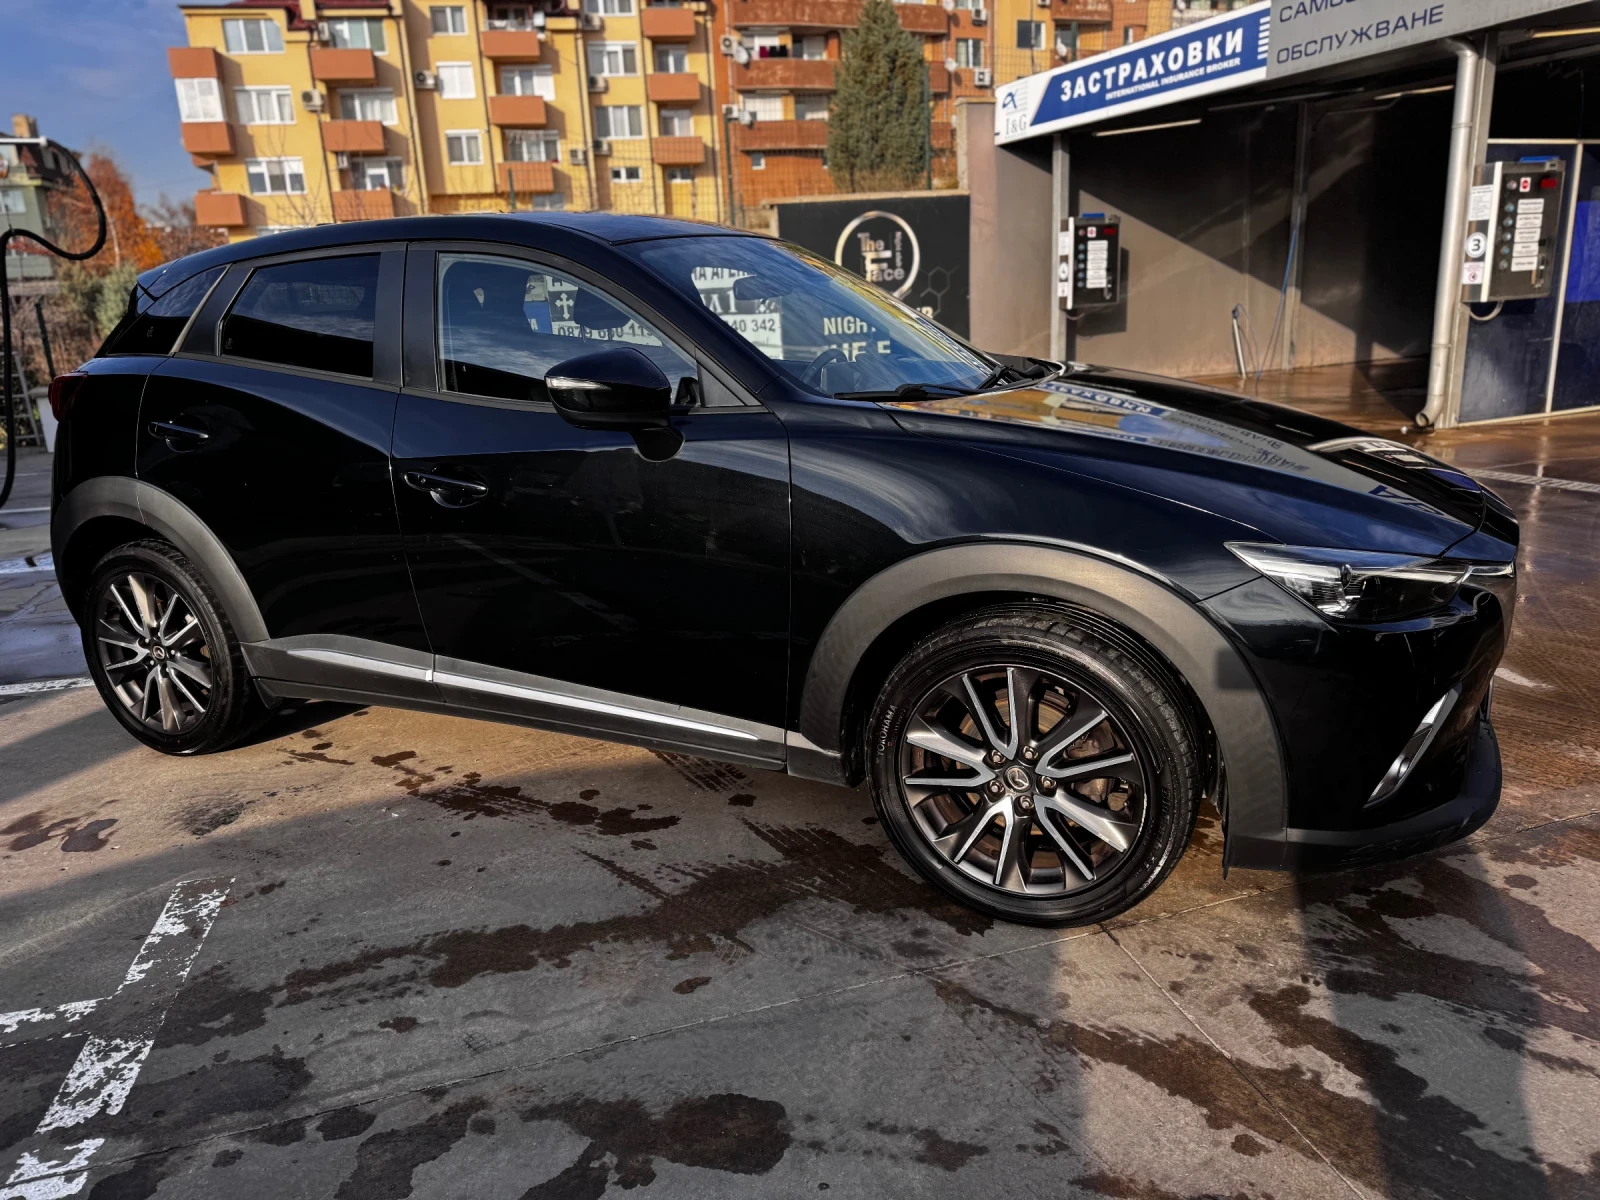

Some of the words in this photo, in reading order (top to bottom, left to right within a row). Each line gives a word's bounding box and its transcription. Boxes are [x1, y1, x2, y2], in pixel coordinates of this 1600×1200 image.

[1276, 4, 1445, 64] ОБСЛУЖВАНЕ
[1060, 27, 1244, 102] ЗАСТРАХОВКИ
[1105, 79, 1160, 100] INTERNATIONAL
[1160, 67, 1205, 86] INSURANCE
[1206, 57, 1241, 74] BROKER
[1005, 113, 1027, 134] I&G
[857, 232, 885, 252] The
[1472, 239, 1480, 251] 3
[862, 250, 905, 283] Face
[751, 318, 776, 333] 342
[877, 704, 898, 756] YOKOHAMA
